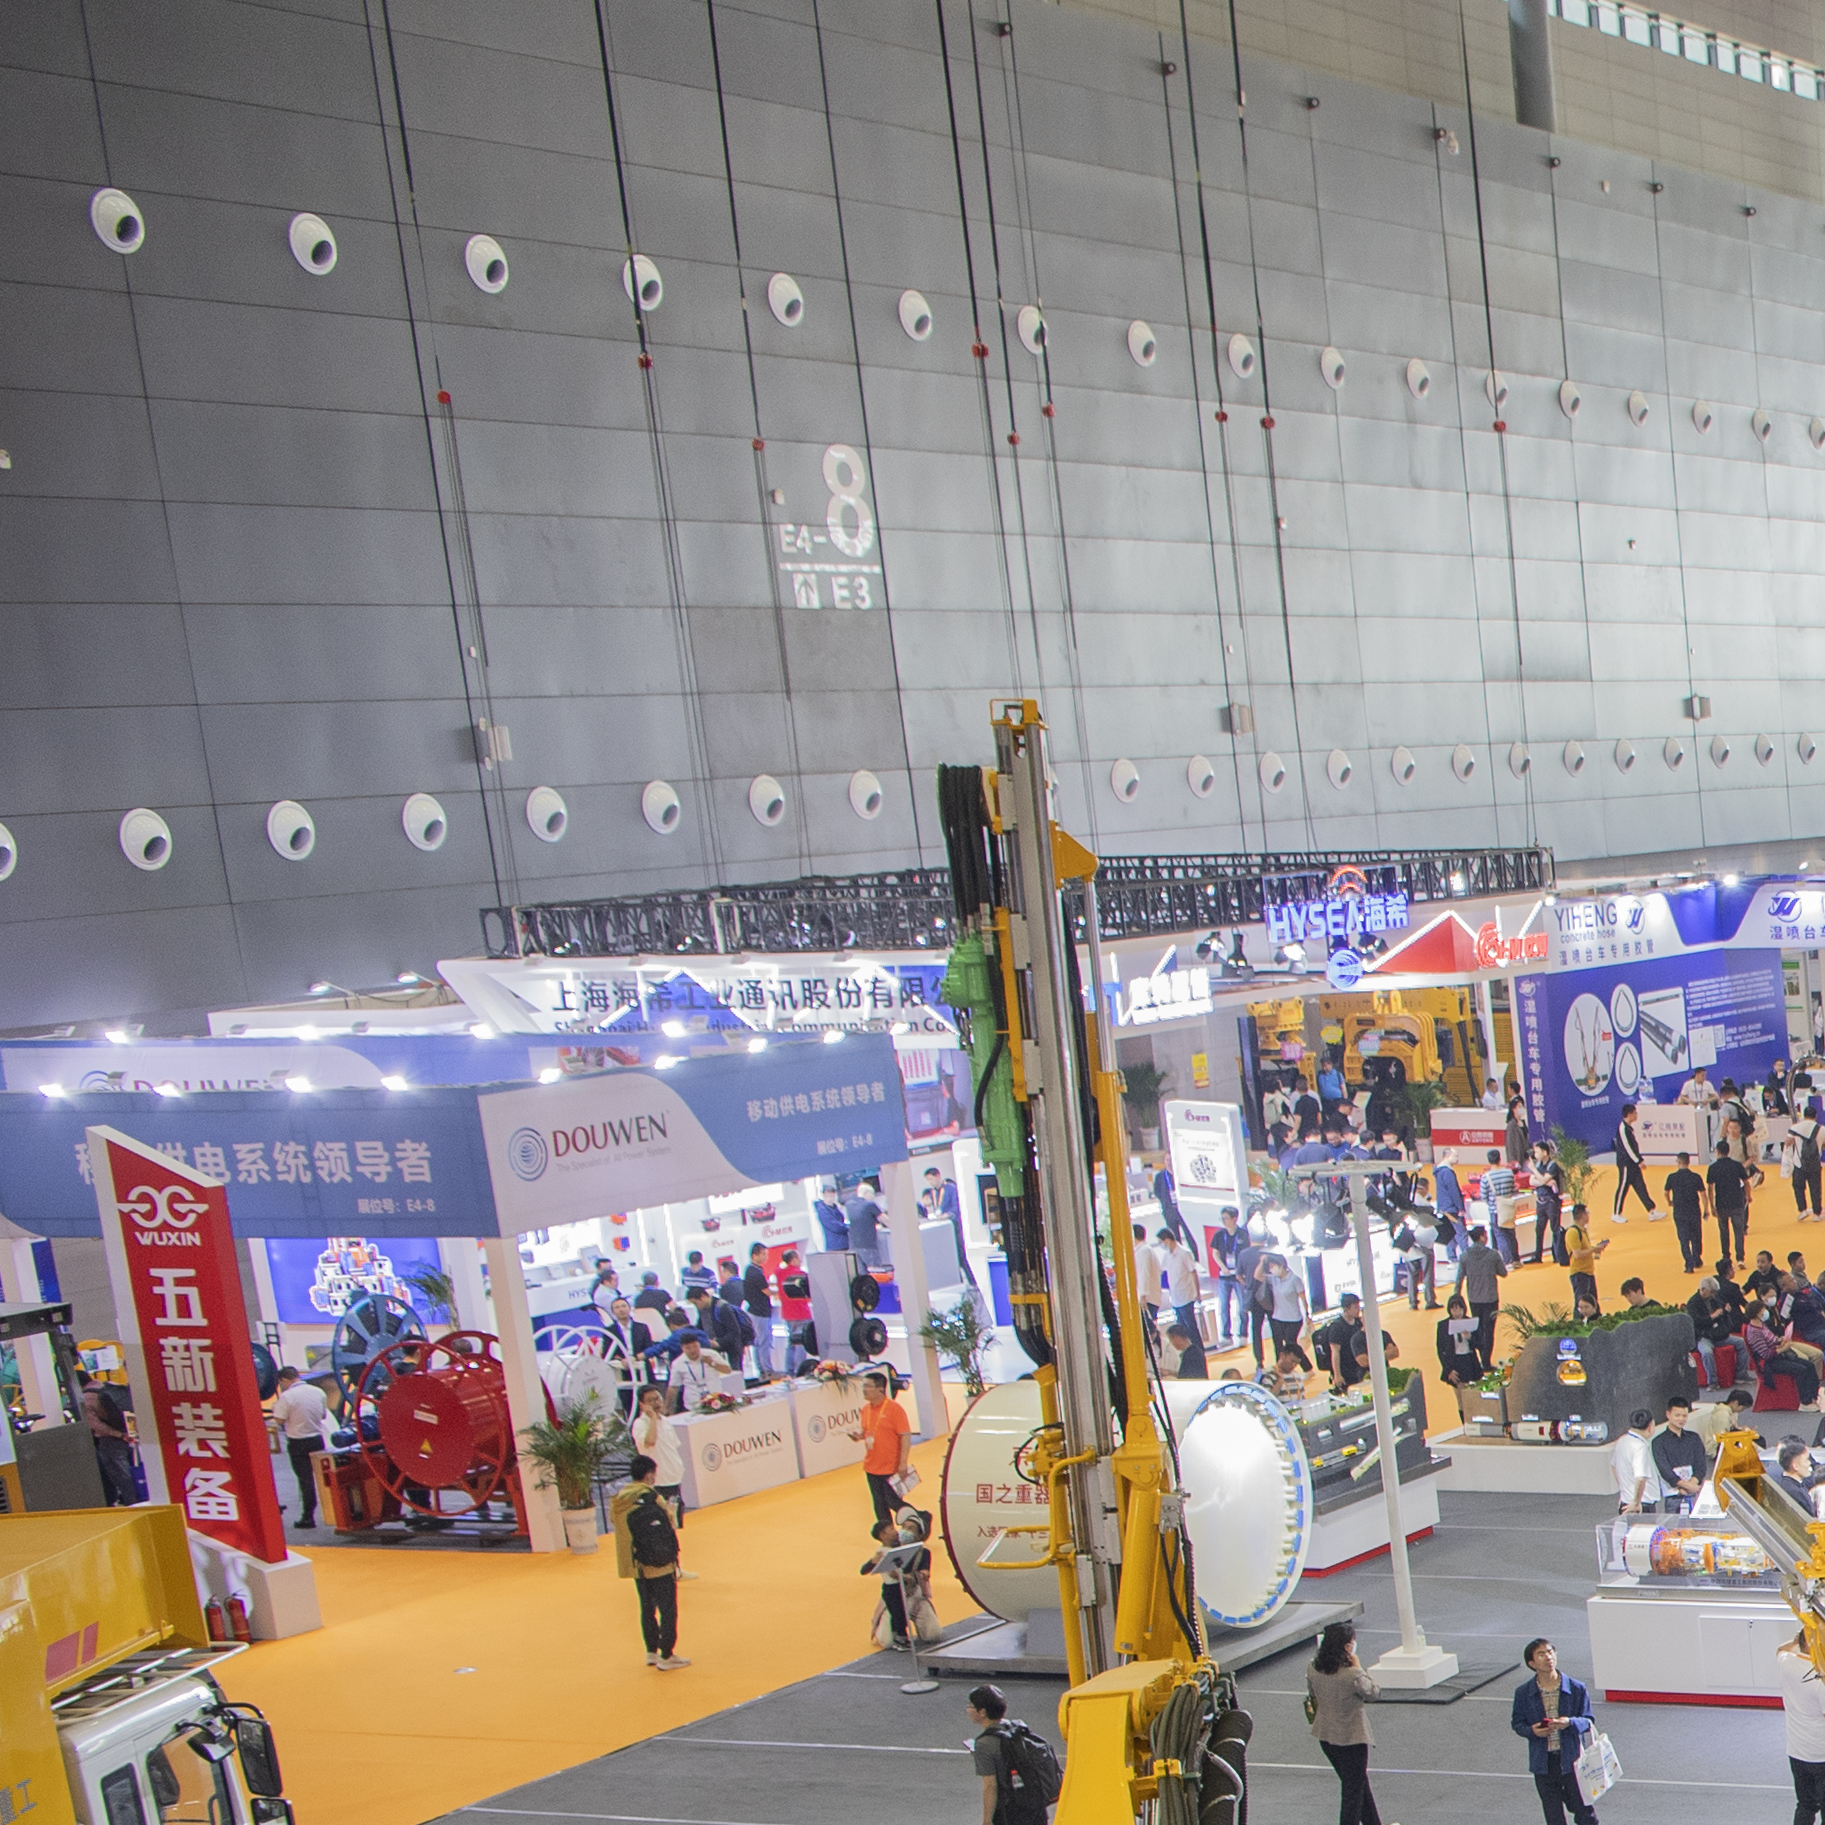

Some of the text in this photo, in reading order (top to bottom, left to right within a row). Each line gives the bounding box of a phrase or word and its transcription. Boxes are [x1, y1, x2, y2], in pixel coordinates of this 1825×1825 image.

[830, 575, 874, 610] E3
[1554, 903, 1618, 931] YIHENG
[1560, 928, 1616, 944] concrete hose
[1522, 999, 1546, 1123] 湿喷台车专用胶管
[746, 1081, 885, 1123] 移动供电系统领导者
[551, 1112, 669, 1158] DOUWEN
[406, 1198, 435, 1212] E4-8
[134, 1231, 202, 1246] WUXIN
[148, 1267, 240, 1524] 五新装备
[724, 1428, 783, 1458] DOUWEN
[975, 1483, 1050, 1506] 国之重器
